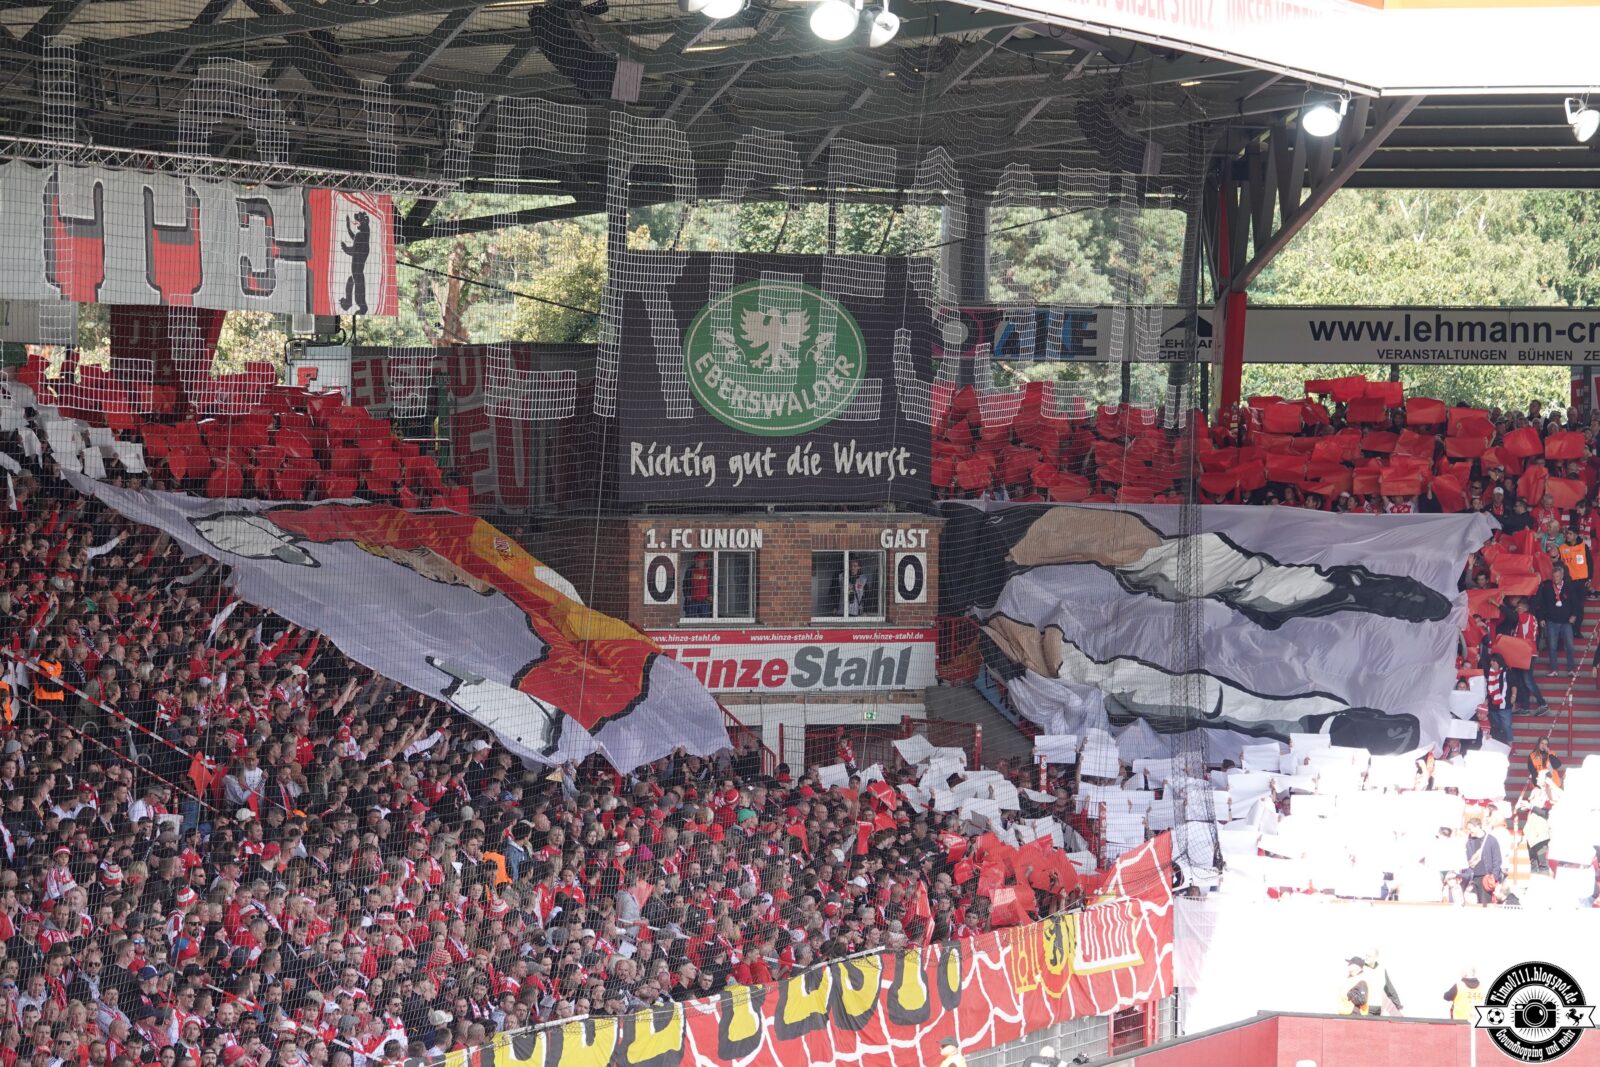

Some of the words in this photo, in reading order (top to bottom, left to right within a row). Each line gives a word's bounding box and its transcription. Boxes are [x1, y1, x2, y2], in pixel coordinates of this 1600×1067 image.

[1309, 314, 1600, 343] www.lehmann-cr
[1377, 349, 1507, 361] VERANSTALTUNGEN
[1518, 349, 1573, 362] BÜHNEN
[1583, 351, 1600, 361] ZE
[694, 351, 855, 417] EBERSWALDER
[630, 441, 717, 488] Richtig
[728, 447, 777, 488] gut
[786, 441, 823, 477] die
[833, 439, 918, 482] Wurst.
[646, 529, 667, 548] 1.
[671, 529, 693, 548] FC
[700, 529, 763, 548] UNION
[880, 529, 929, 548] GAST
[750, 633, 824, 642] www.hinze-stahl.de
[852, 632, 924, 641] www.hinze-stahl.de
